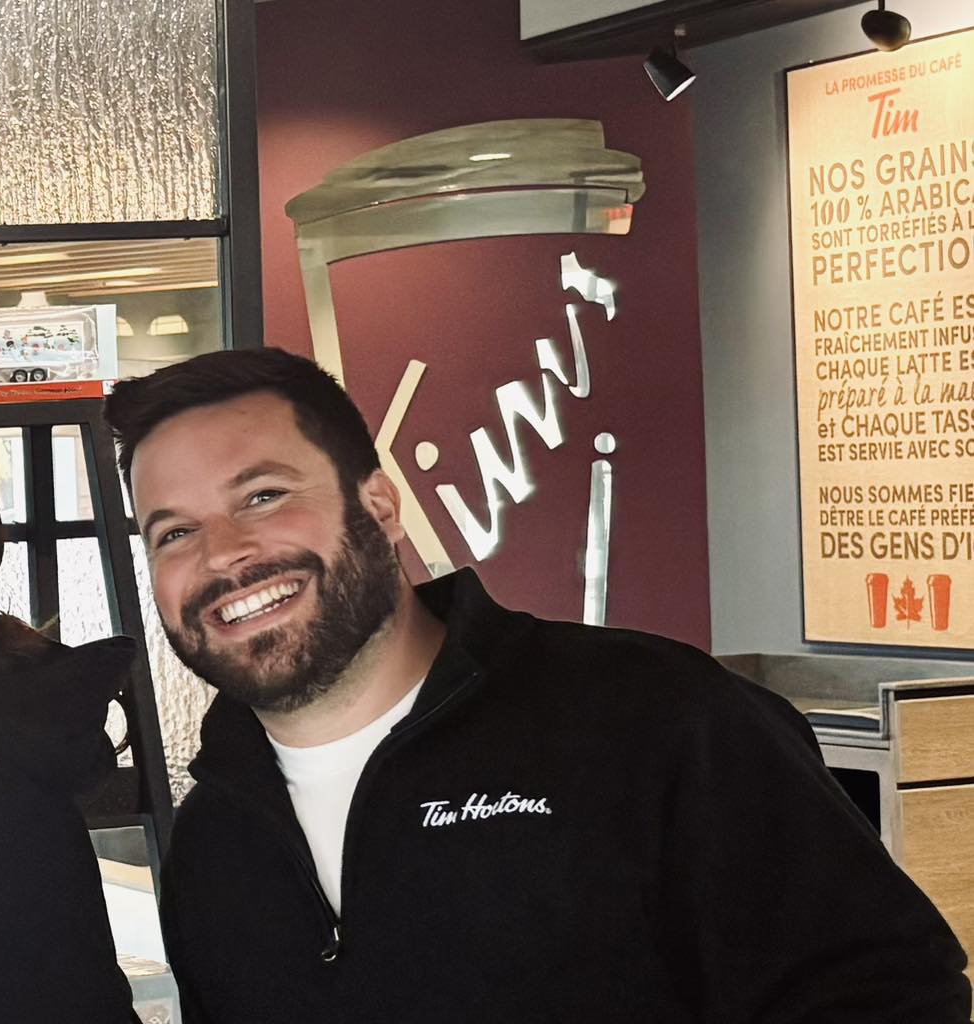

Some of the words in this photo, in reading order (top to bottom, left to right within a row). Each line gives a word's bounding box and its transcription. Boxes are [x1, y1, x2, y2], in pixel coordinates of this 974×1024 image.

[825, 81, 840, 95] LA
[842, 66, 906, 92] PROMESSE
[909, 62, 926, 78] DU
[929, 52, 962, 74] CAFÉ
[867, 87, 919, 139] Tim
[809, 159, 865, 196] NOS
[875, 139, 974, 185] GRAIN
[810, 197, 851, 227] 100
[857, 194, 872, 221] %
[879, 178, 974, 217] ARABIC
[811, 228, 853, 250] SONT
[857, 211, 947, 244] TORRÉFIÉS
[951, 207, 964, 232] À
[812, 236, 974, 286] PERFECTIO
[814, 303, 882, 333] NOTRE
[889, 290, 945, 326] CAFÉ
[815, 328, 929, 356] FRAÎCHEMENT
[933, 325, 974, 347] INFU
[816, 357, 889, 380] CHAQUE
[897, 351, 952, 375] LATTE
[817, 376, 888, 422] préparé
[894, 375, 908, 406] à
[914, 372, 935, 405] la
[817, 417, 836, 439] et
[841, 411, 927, 438] CHAQUE
[818, 443, 845, 461] EST
[848, 440, 903, 461] SERVIE
[907, 439, 950, 459] AVEC
[819, 486, 864, 504] NOUS
[868, 484, 944, 504] SOMMES
[868, 509, 884, 526] LE
[888, 504, 926, 526] CAFÉ
[820, 531, 864, 560] DES
[870, 531, 935, 560] GENS
[941, 531, 974, 561] D'I
[420, 800, 458, 827] Tim
